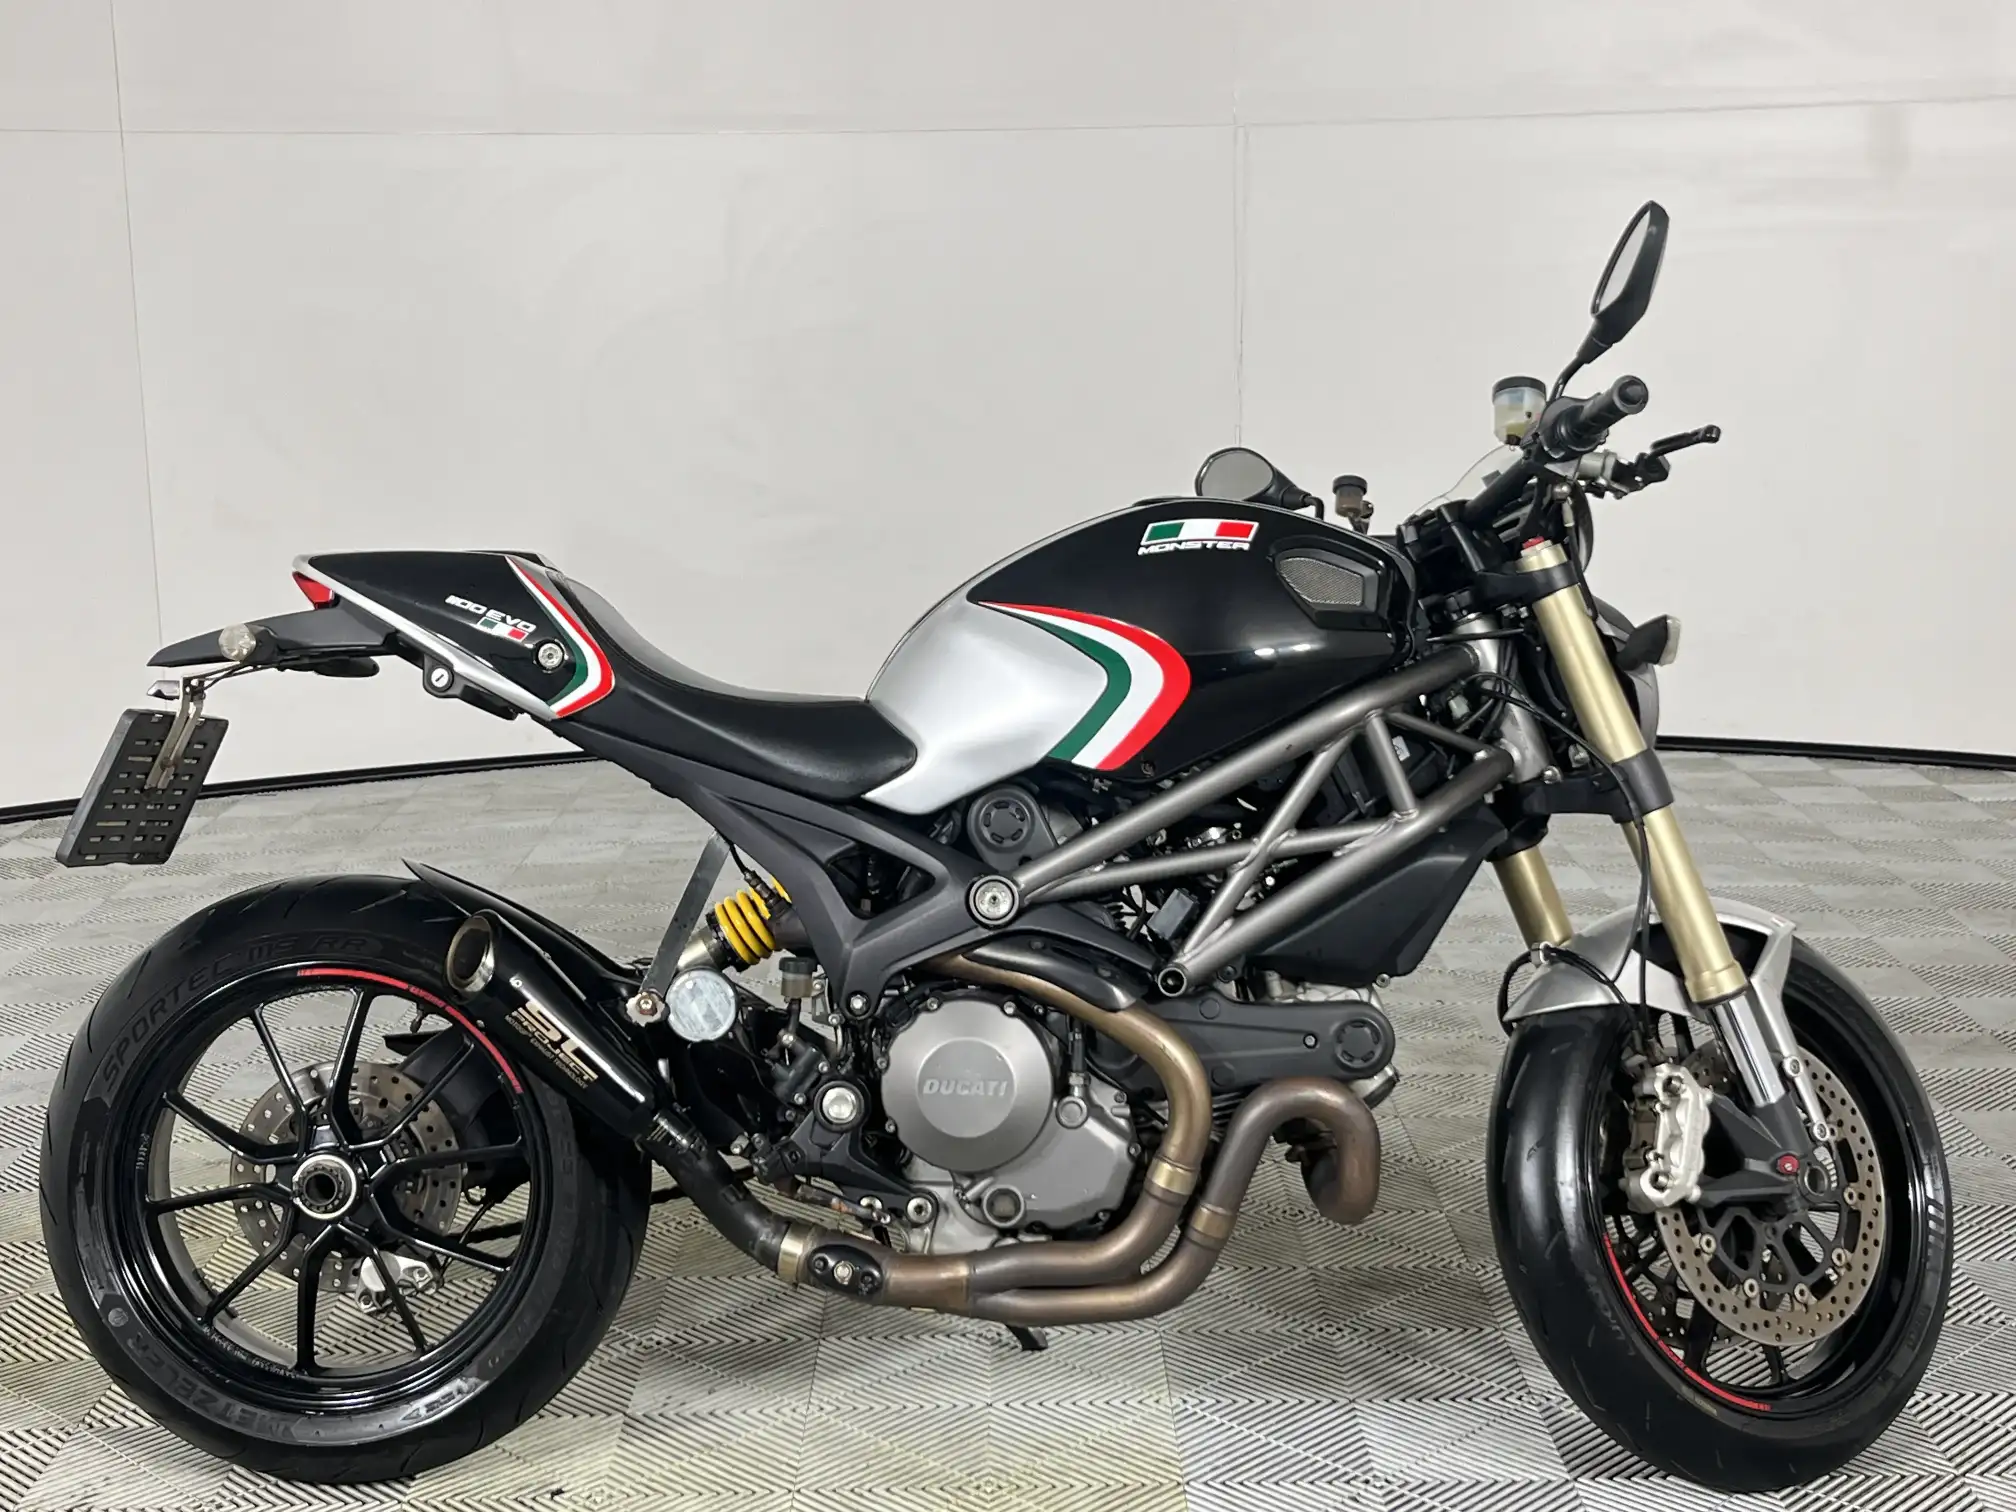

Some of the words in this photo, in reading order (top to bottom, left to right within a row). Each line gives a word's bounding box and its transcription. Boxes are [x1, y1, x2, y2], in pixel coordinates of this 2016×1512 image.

[1138, 541, 1251, 555] MONSTER
[486, 609, 537, 633] EVO
[102, 952, 233, 1091] SPORTEC
[511, 1008, 597, 1082] PROJECT
[922, 1079, 1008, 1097] DUCATI
